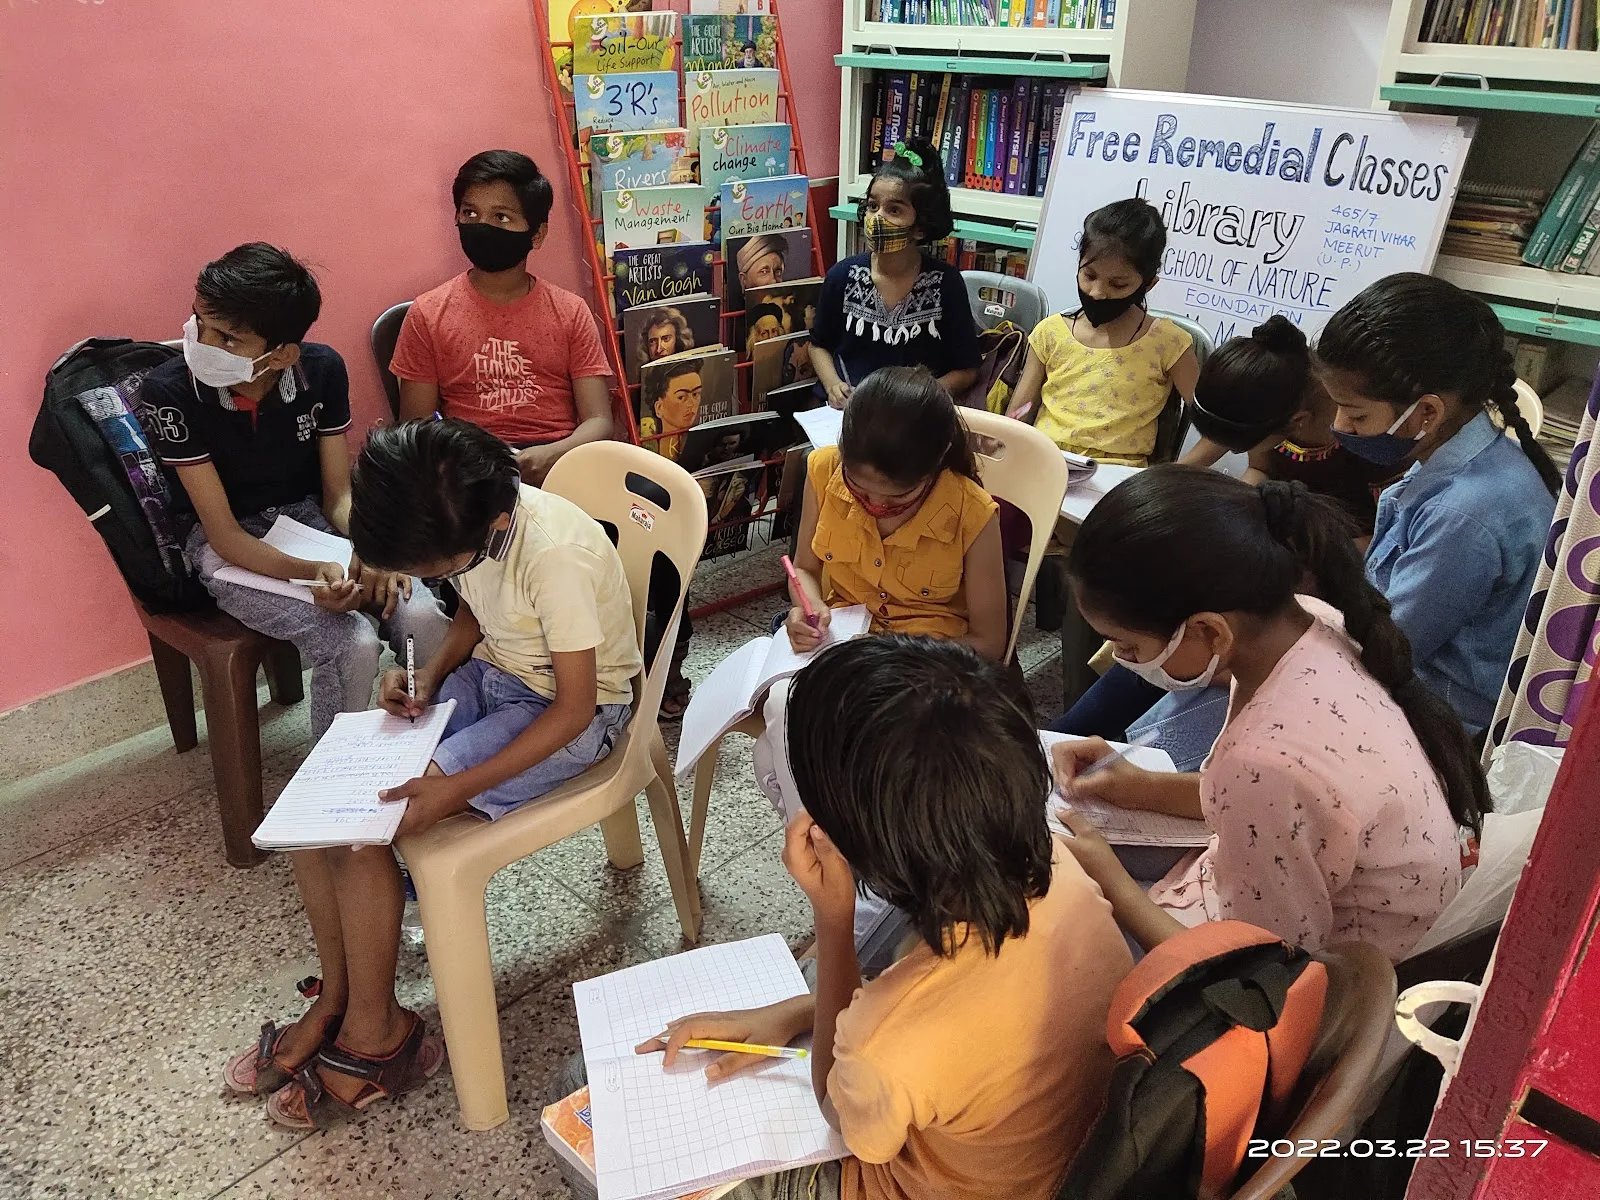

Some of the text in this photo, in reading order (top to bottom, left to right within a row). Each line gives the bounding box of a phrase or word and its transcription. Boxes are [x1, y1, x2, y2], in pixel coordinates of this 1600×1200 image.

[600, 31, 664, 57] Soil-Our
[691, 37, 721, 56] ARTISTS
[597, 53, 656, 73] Life Support
[685, 55, 737, 71] Monet
[606, 82, 658, 116] 3'R's
[692, 88, 769, 122] Pollution
[893, 90, 902, 112] JEE
[725, 135, 781, 157] Climate
[953, 126, 961, 149] CMAT
[1012, 131, 1020, 155] NTSE
[1039, 130, 1050, 156] BCA
[713, 153, 757, 172] change
[1067, 112, 1141, 162] Free
[1148, 114, 1323, 183] Remedial
[1323, 132, 1448, 201] Classes
[614, 166, 667, 190] Rivers
[634, 197, 682, 217] Waste
[742, 191, 793, 221] Earth
[1331, 204, 1378, 227] 465/7
[614, 209, 691, 231] Management
[729, 221, 784, 235] Our Big Home
[1325, 220, 1416, 250] JAGRATI VIHAR
[1323, 237, 1384, 258] MEERUT
[628, 253, 661, 267] THE GREAT
[628, 265, 662, 285] ARTISTS
[1162, 247, 1337, 308] CHOOL OF NATURE
[622, 270, 702, 306] Van Gogh
